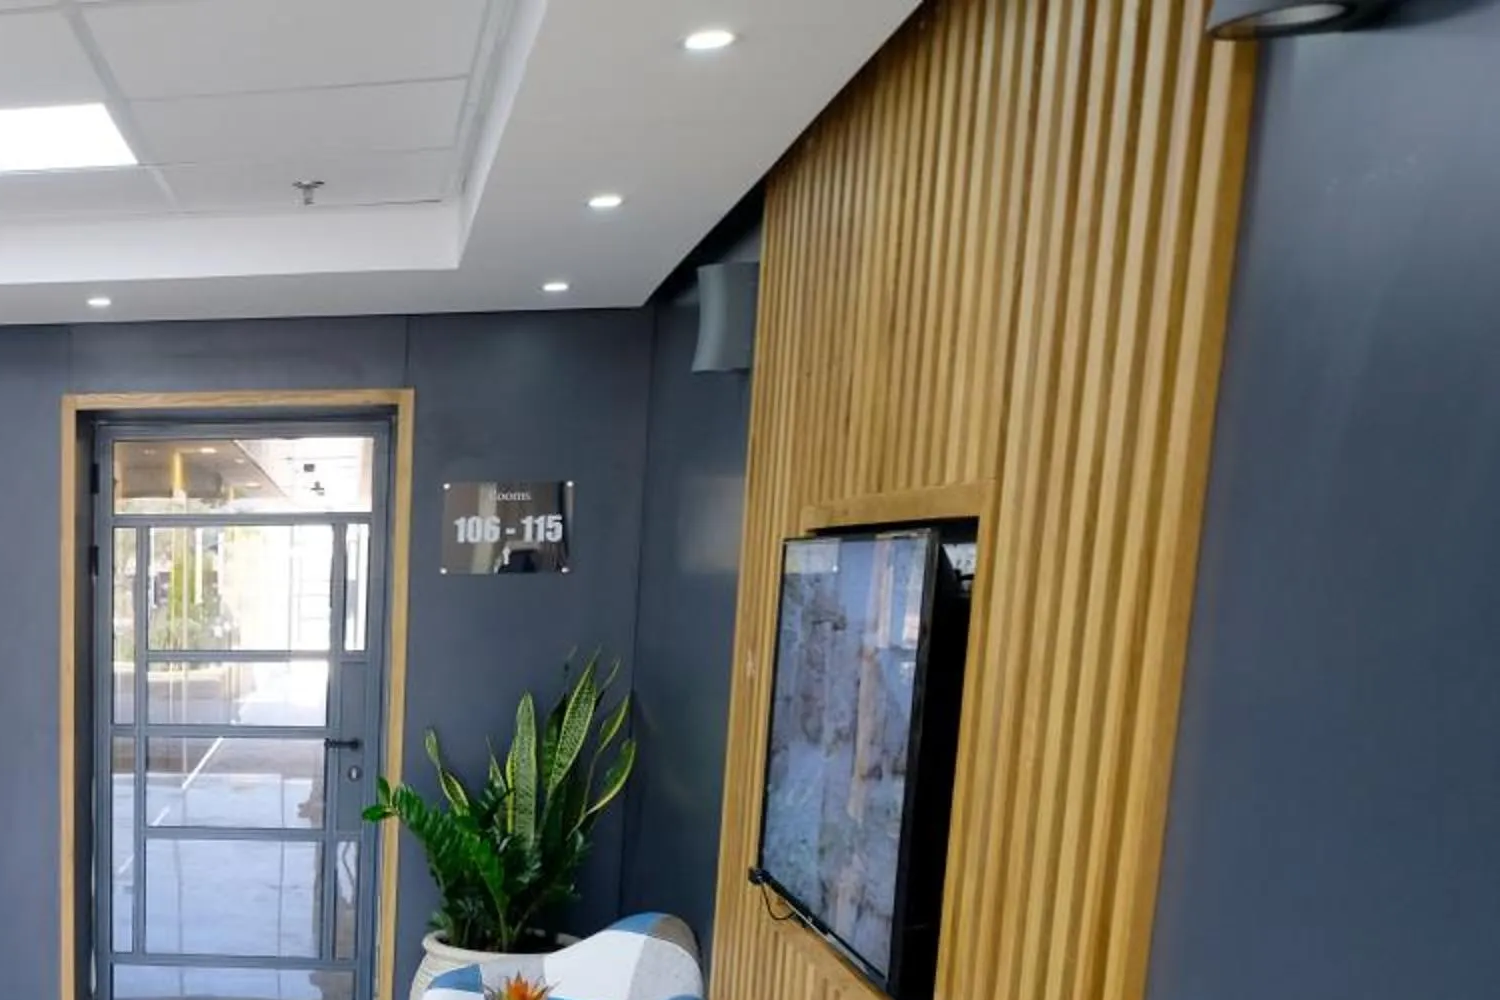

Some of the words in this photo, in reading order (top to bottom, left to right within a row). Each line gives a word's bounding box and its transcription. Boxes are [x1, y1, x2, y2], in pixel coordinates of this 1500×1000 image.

[490, 489, 531, 501] ooms
[454, 515, 500, 543] 106
[520, 514, 563, 543] 115
